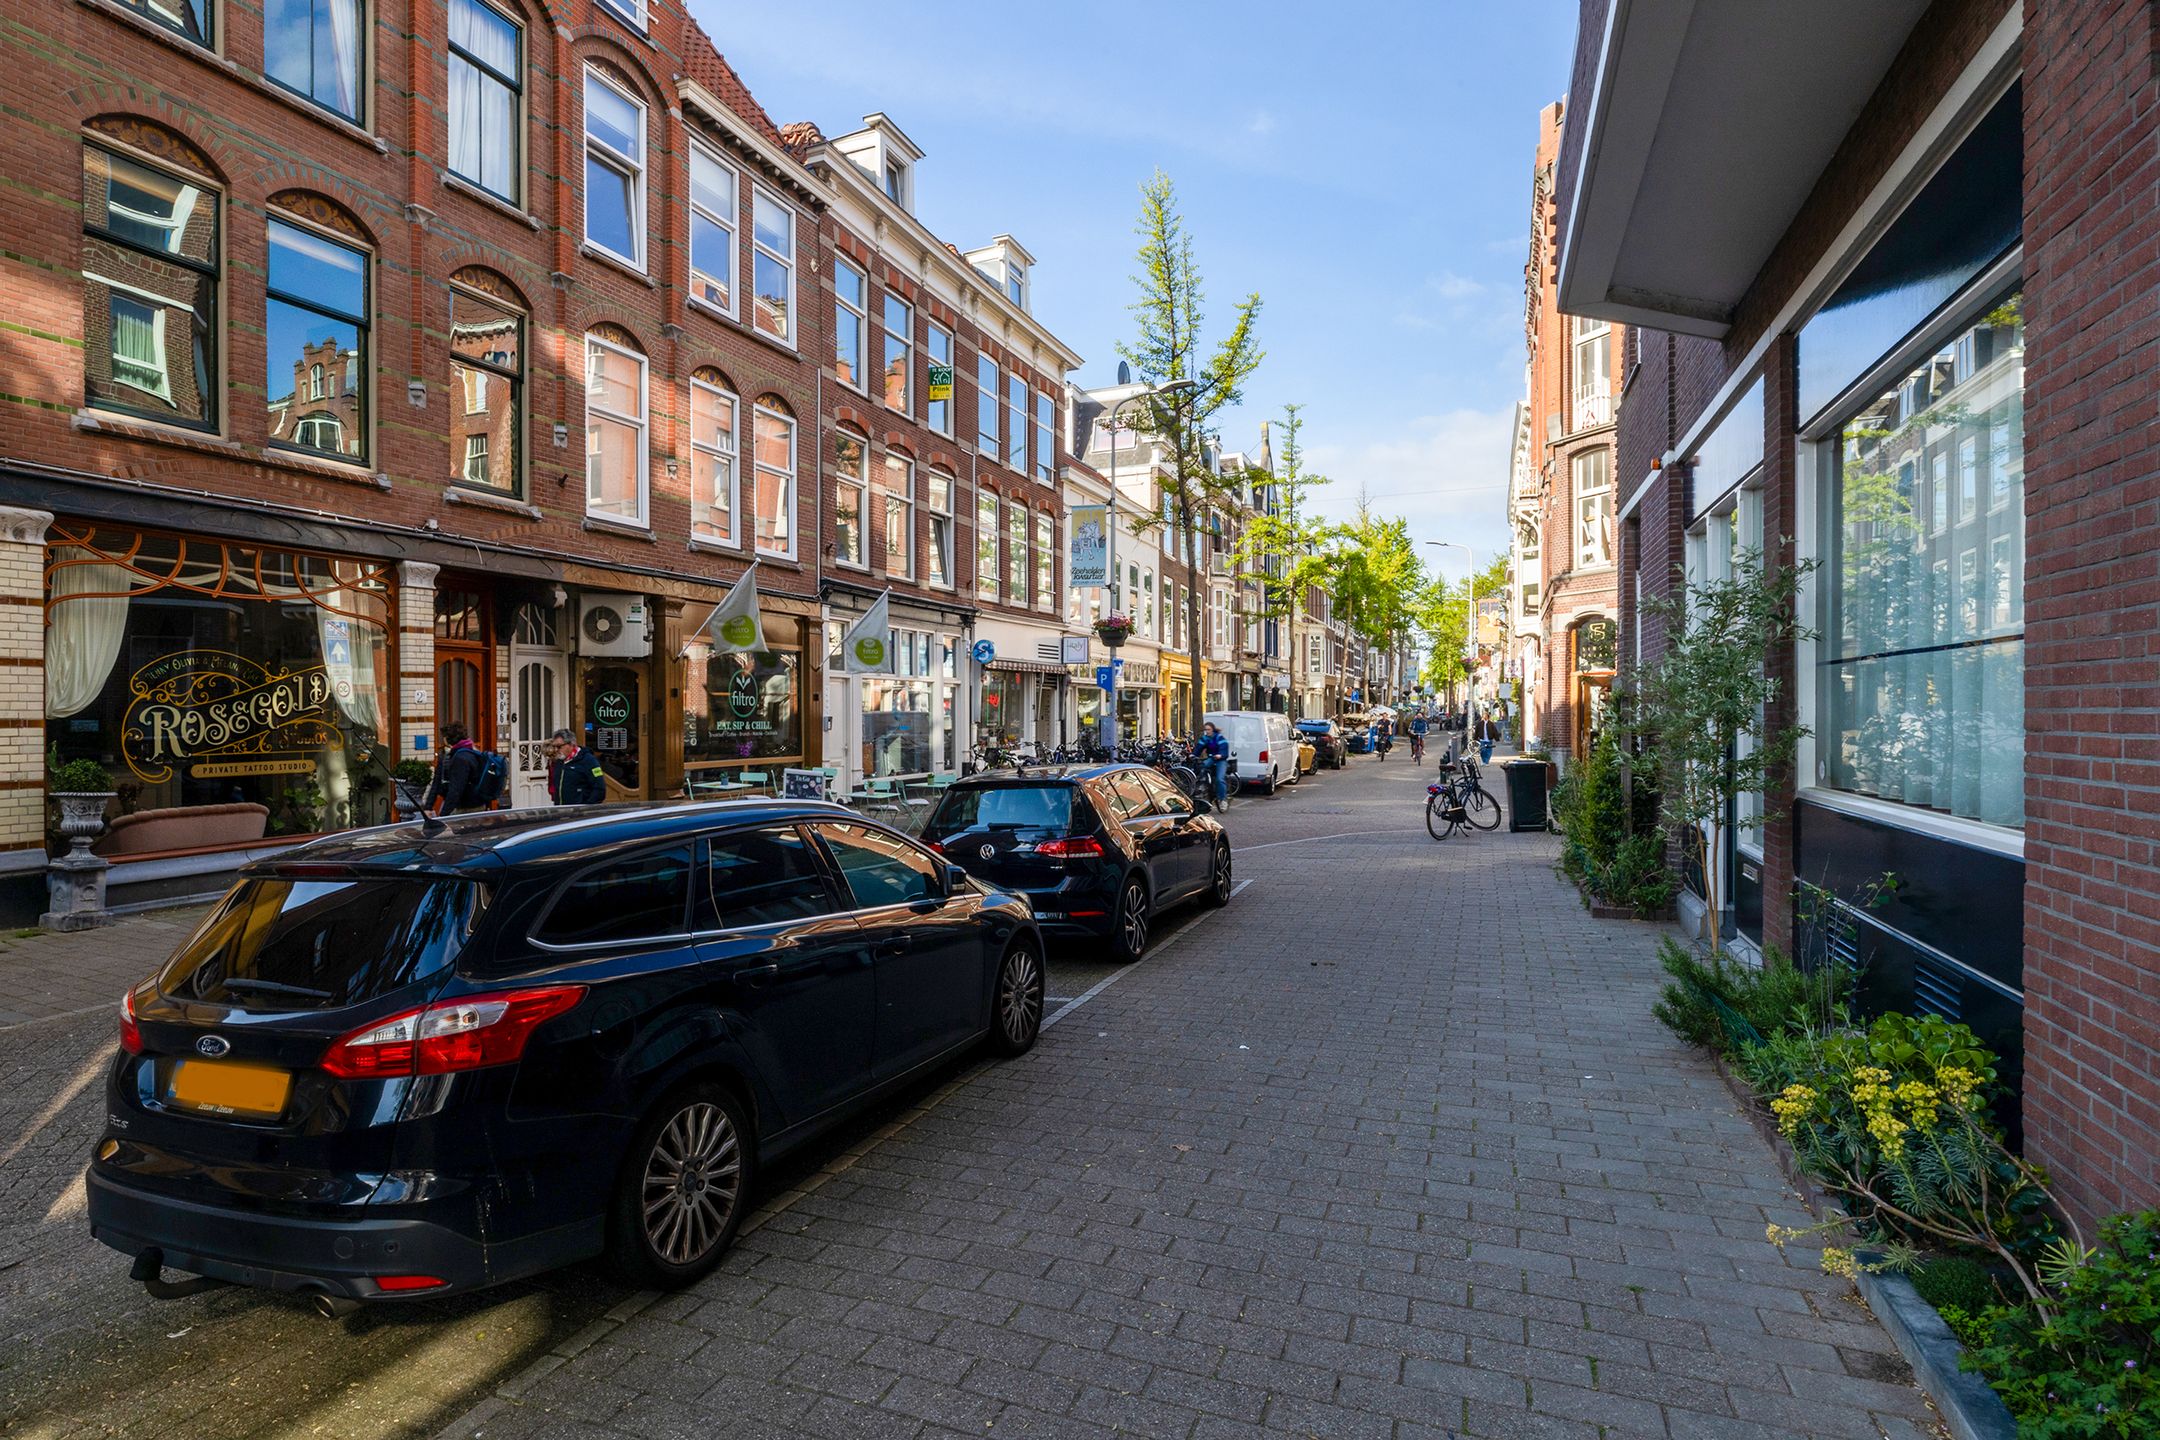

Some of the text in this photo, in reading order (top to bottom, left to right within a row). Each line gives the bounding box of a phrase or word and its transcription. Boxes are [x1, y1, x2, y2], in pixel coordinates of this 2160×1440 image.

[1100, 674, 1107, 684] P
[732, 691, 756, 706] filtro
[139, 672, 331, 761] ROSEGOLD
[598, 706, 627, 717] filtro
[511, 712, 518, 723] 6
[732, 721, 745, 730] SIP
[745, 721, 751, 730] &
[751, 720, 772, 730] CHILL
[202, 762, 307, 774] PRIVATE TATTOO STUDIO
[201, 1038, 220, 1052] Ford
